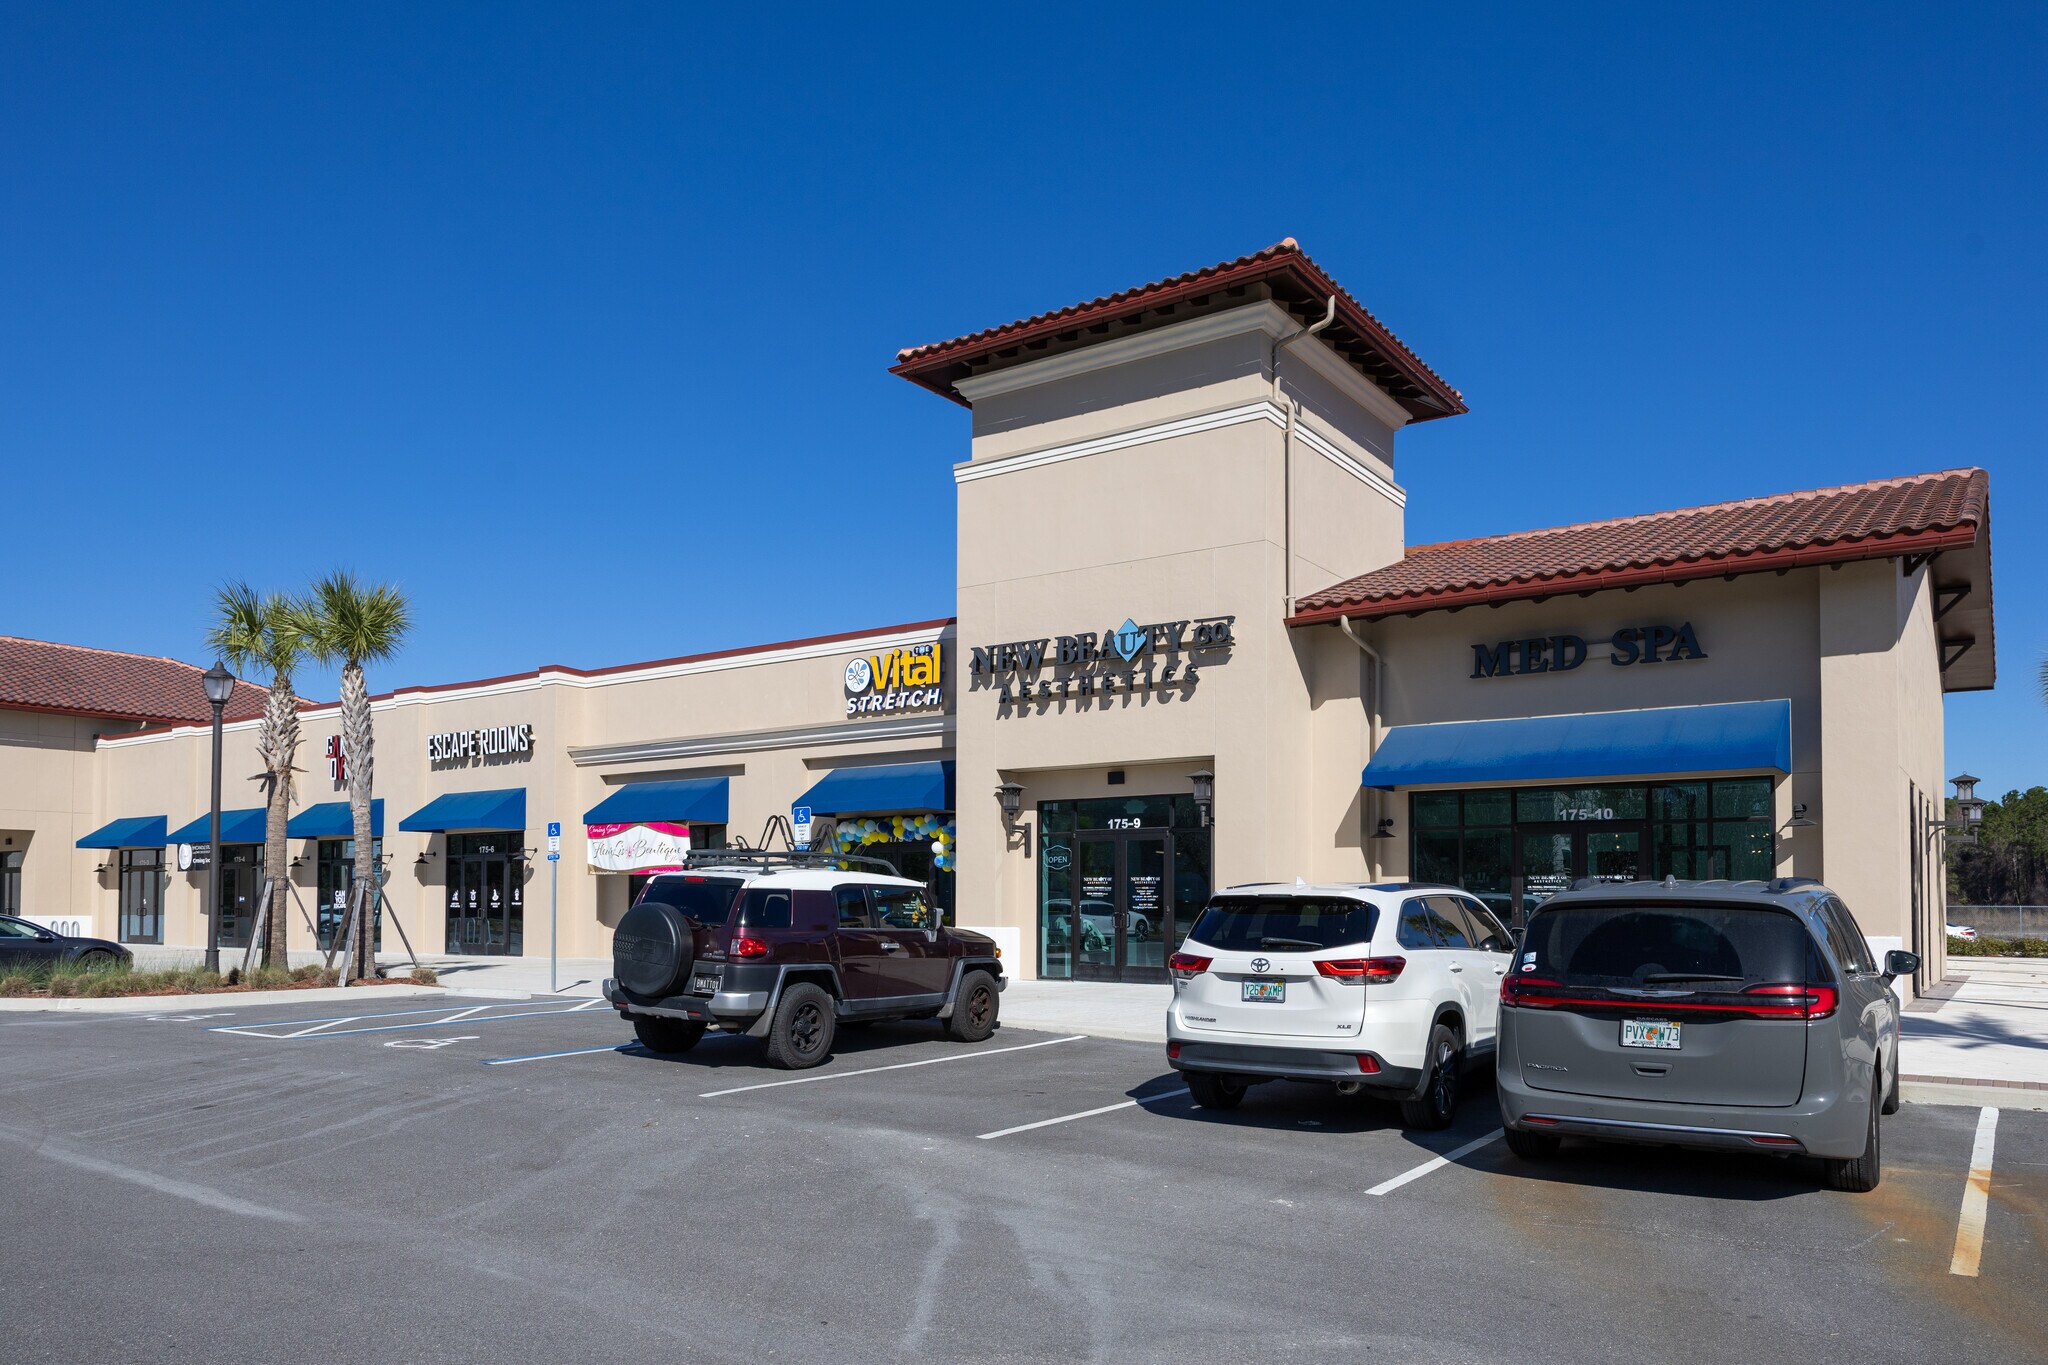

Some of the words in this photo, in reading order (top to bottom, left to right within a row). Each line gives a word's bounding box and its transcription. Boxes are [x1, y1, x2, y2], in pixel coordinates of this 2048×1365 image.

[914, 645, 931, 654] THE
[970, 638, 1051, 676] NEW
[1053, 618, 1191, 666] BEAUTY
[1470, 634, 1588, 679] MED
[1610, 622, 1709, 666] SPA
[870, 643, 942, 690] Vital
[999, 664, 1199, 704] AESTHETICS
[846, 688, 942, 714] STRETCH
[427, 730, 477, 761] ESCAPE
[479, 724, 531, 755] ROOMS
[1559, 807, 1614, 821] 175-10
[1107, 817, 1141, 830] 175-9
[588, 825, 606, 836] Coming
[478, 845, 495, 854] 175-6
[632, 839, 681, 863] Boutique
[1048, 855, 1068, 864] OPEN
[334, 896, 346, 904] YOU
[696, 979, 719, 989] BMATTOX
[1245, 984, 1259, 996] Y26
[1268, 985, 1283, 997] XMP
[1184, 1015, 1217, 1023] HIGHLANDER
[1625, 1025, 1645, 1039] PVX
[1659, 1027, 1680, 1042] W73
[1526, 1062, 1569, 1072] PACIFICA
